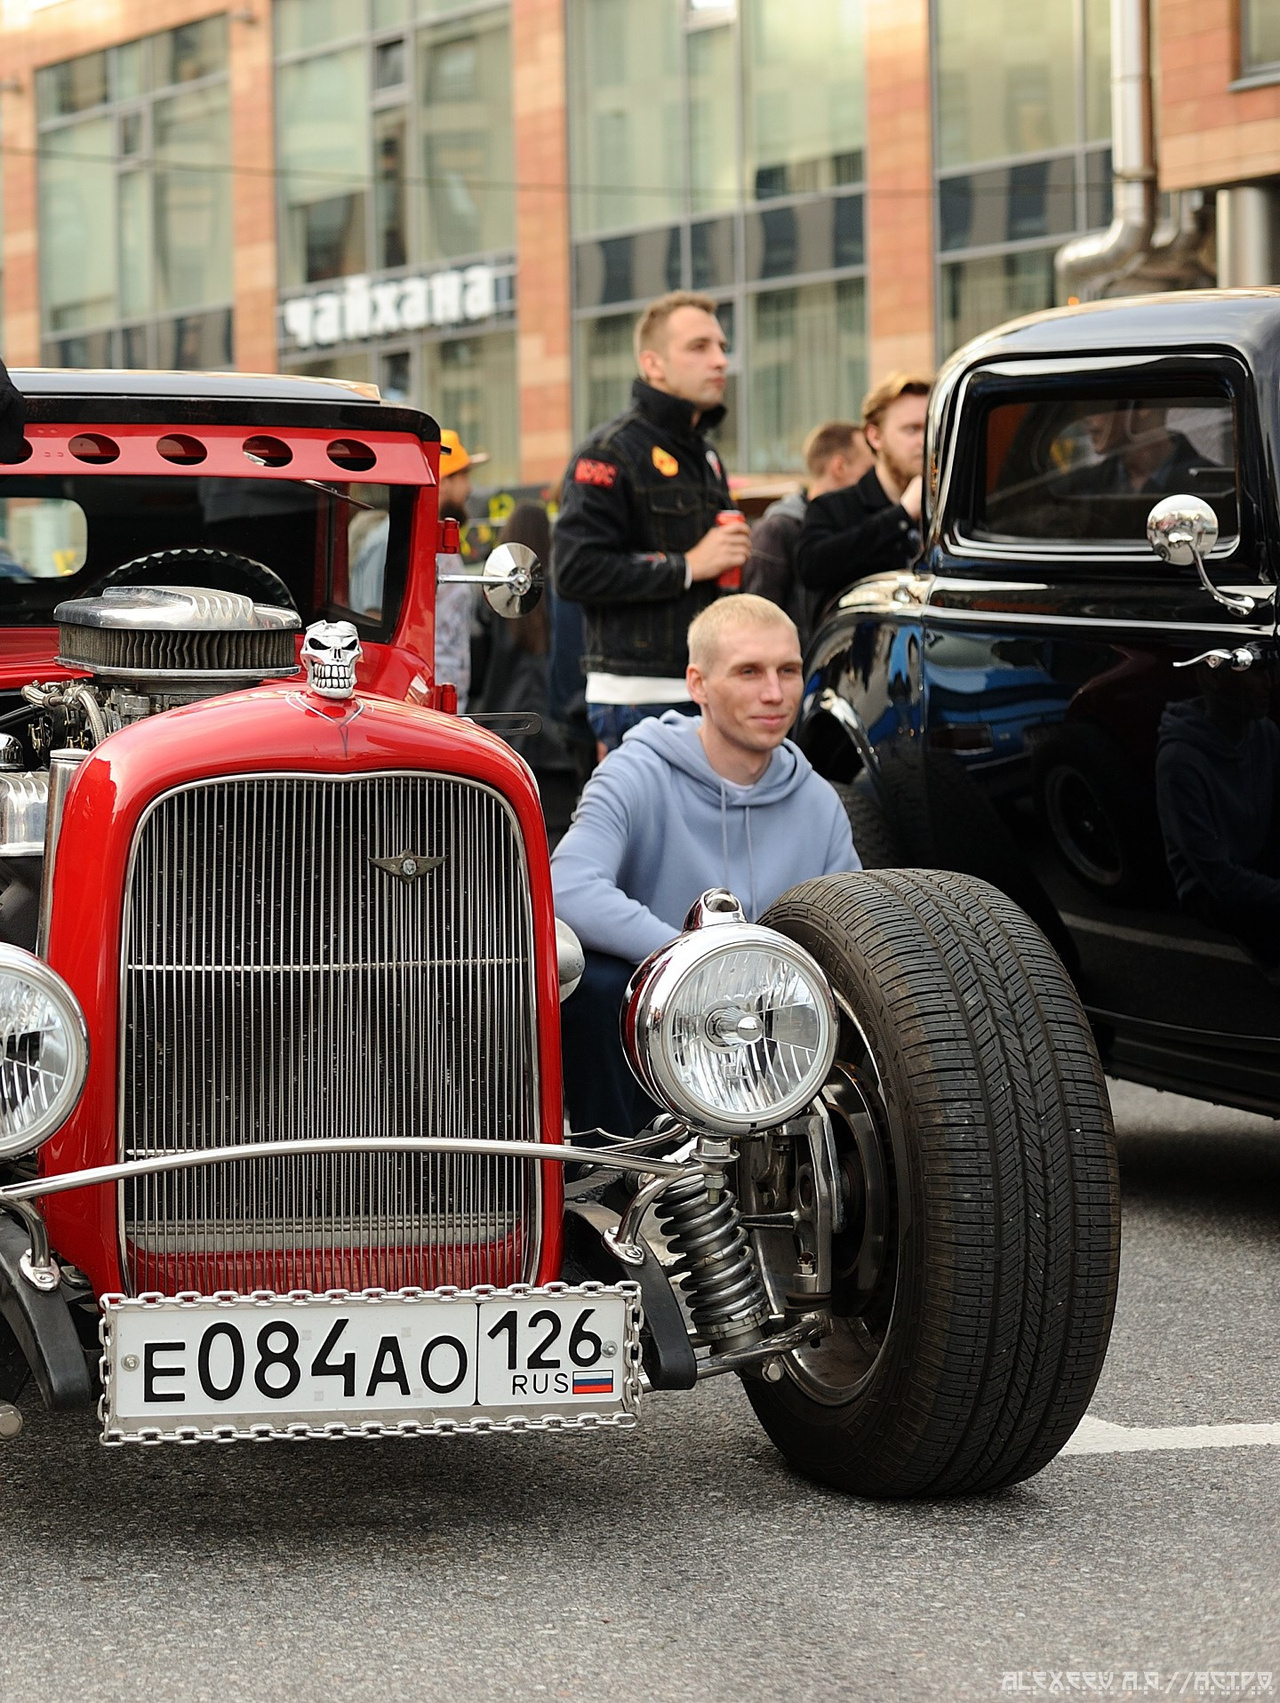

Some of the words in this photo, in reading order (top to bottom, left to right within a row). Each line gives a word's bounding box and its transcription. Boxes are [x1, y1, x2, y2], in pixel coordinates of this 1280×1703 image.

[285, 265, 495, 348] чайхана
[487, 1308, 603, 1370] 126
[512, 1372, 569, 1395] RUS
